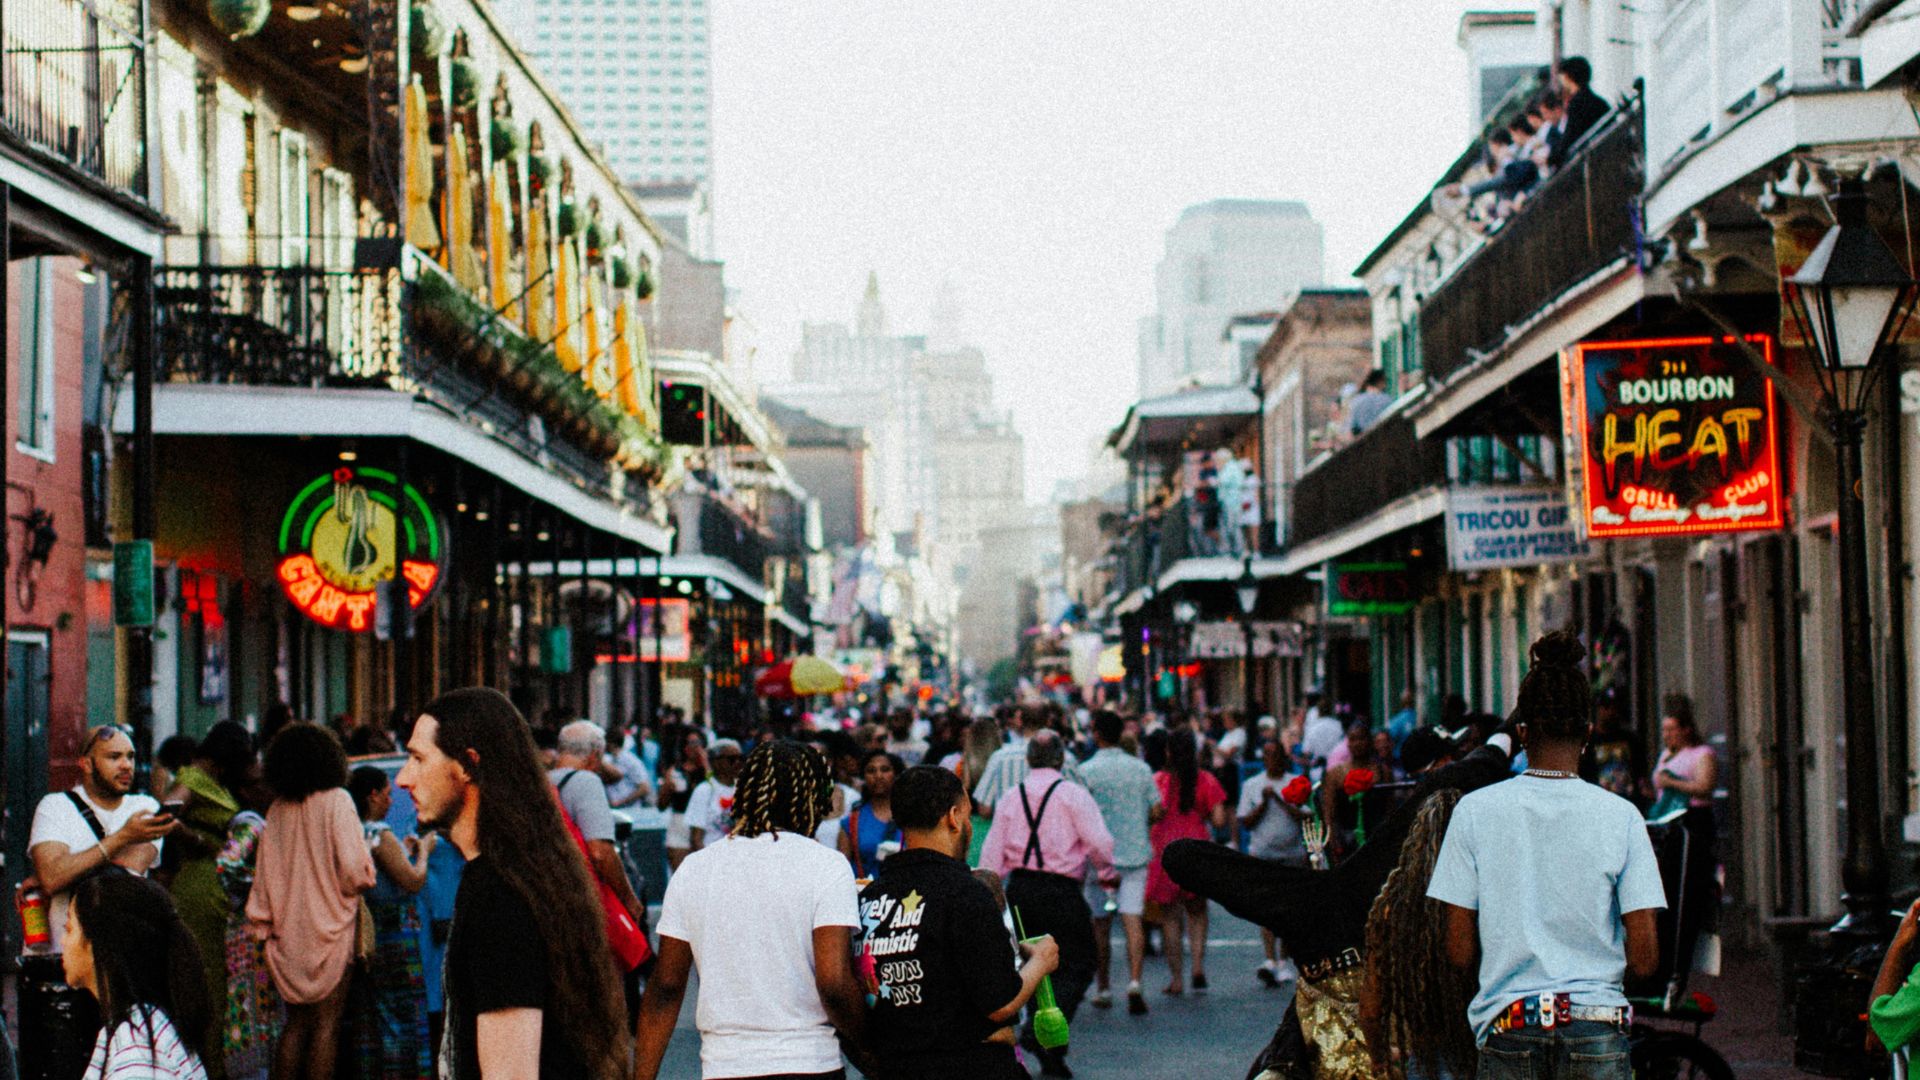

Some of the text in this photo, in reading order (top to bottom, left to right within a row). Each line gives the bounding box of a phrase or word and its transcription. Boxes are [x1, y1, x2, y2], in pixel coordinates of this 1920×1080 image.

[1661, 360, 1687, 375] 711
[1619, 376, 1735, 404] BOURBON
[1602, 406, 1764, 486] HEAT
[1621, 486, 1679, 511] GRILL
[1722, 470, 1771, 502] CLUB
[1456, 506, 1570, 531] TRICOU GIF
[1464, 547, 1527, 560] LOWEST
[277, 554, 439, 630] CANTA
[860, 894, 896, 922] ively
[889, 902, 926, 929] And
[881, 959, 924, 984] SUN
[891, 984, 922, 1007] NY
